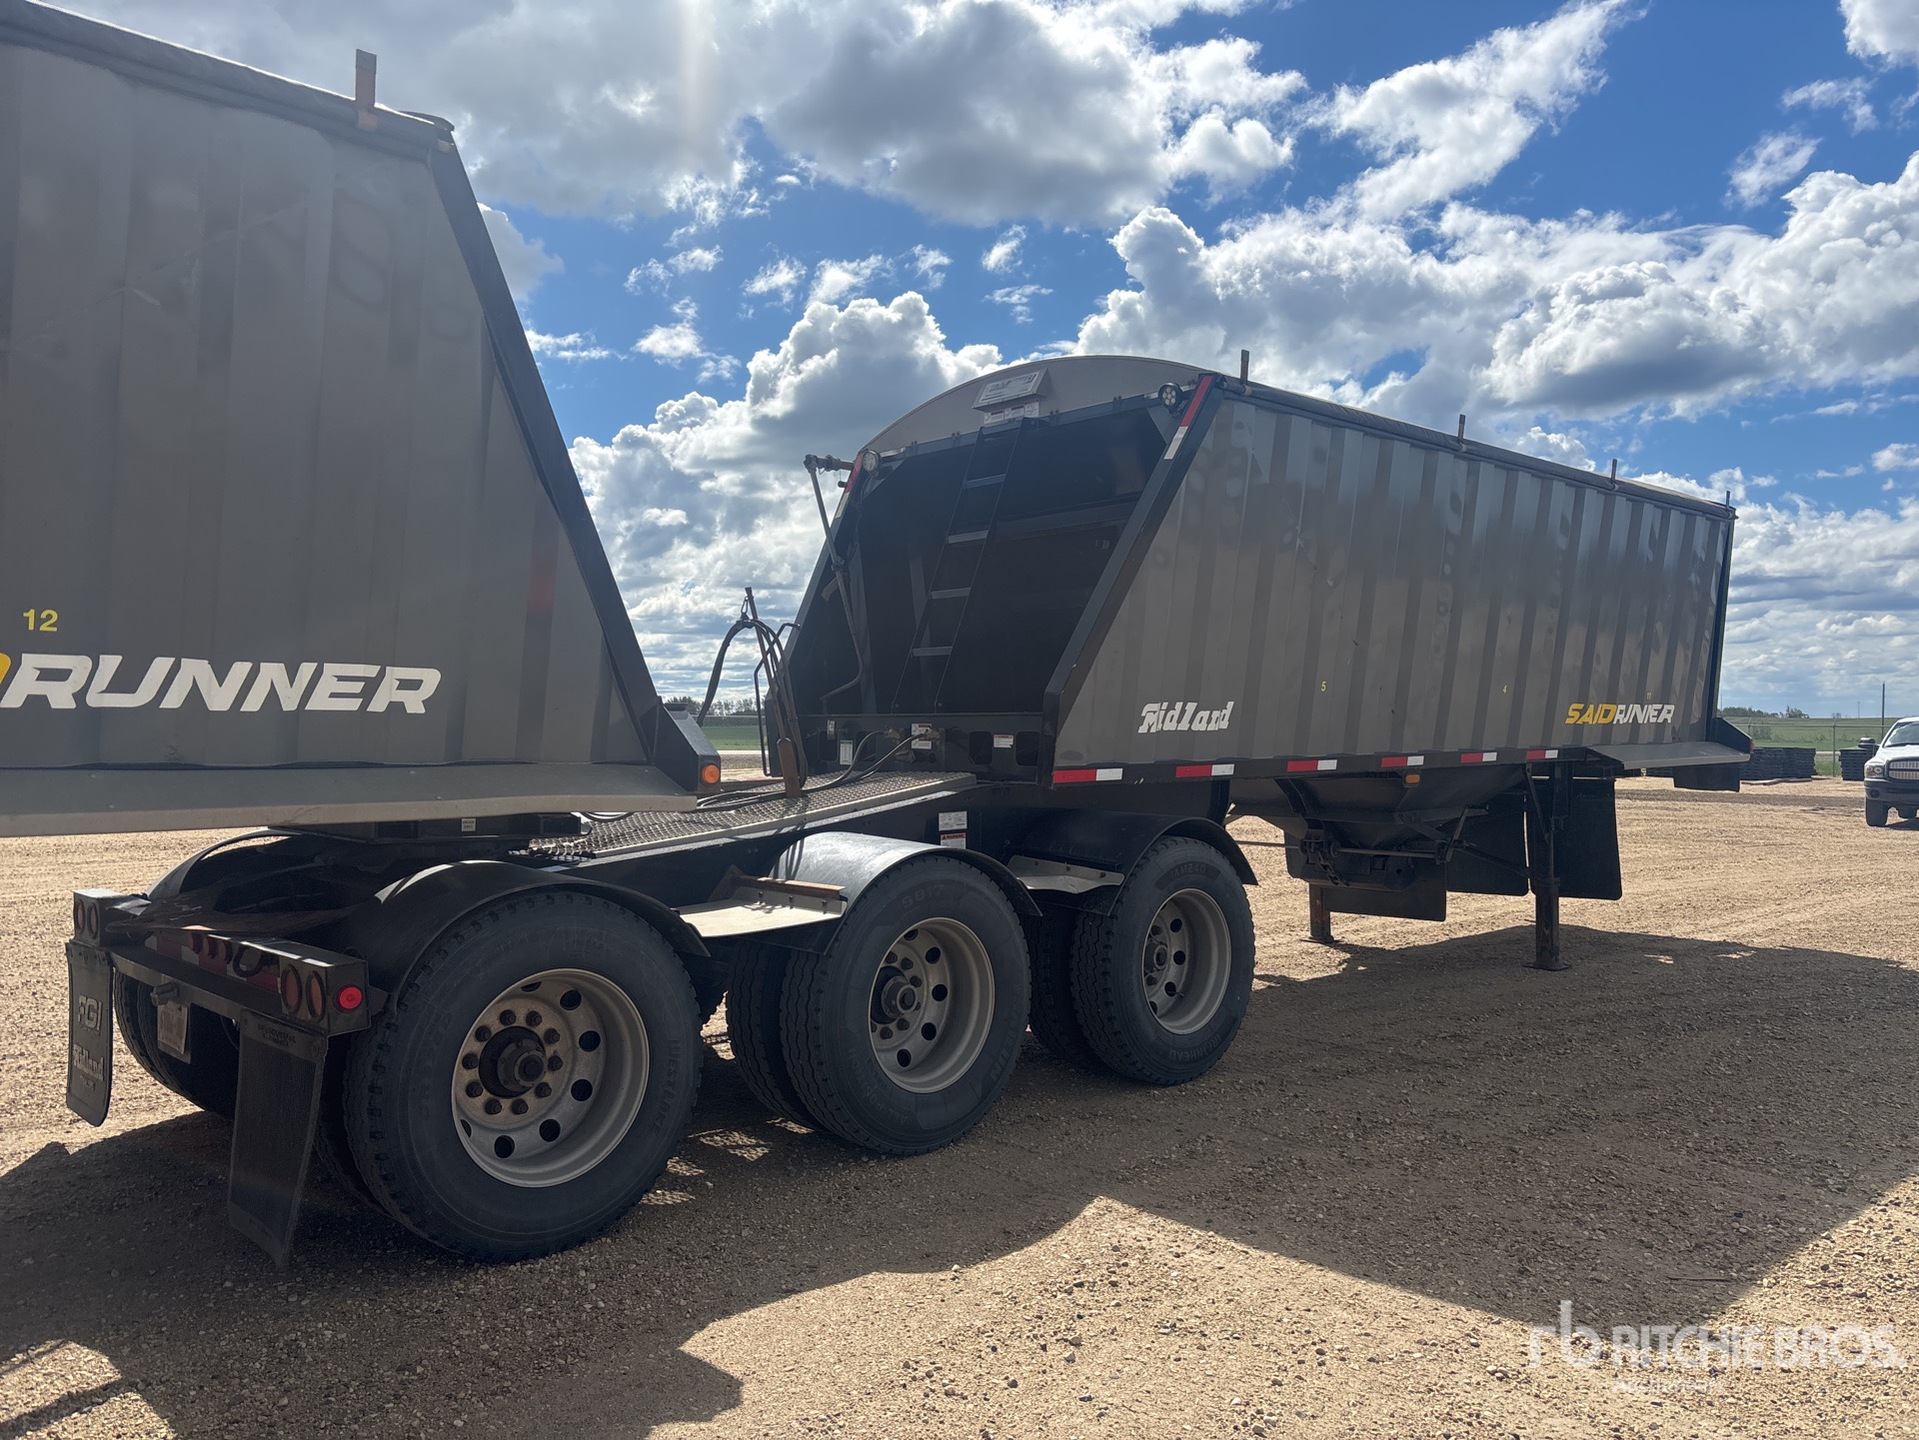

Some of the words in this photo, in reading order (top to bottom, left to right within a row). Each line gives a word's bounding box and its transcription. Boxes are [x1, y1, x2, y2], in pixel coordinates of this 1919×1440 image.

[22, 608, 59, 632] 12
[0, 652, 442, 714] RUNNER
[1320, 680, 1327, 692] 5
